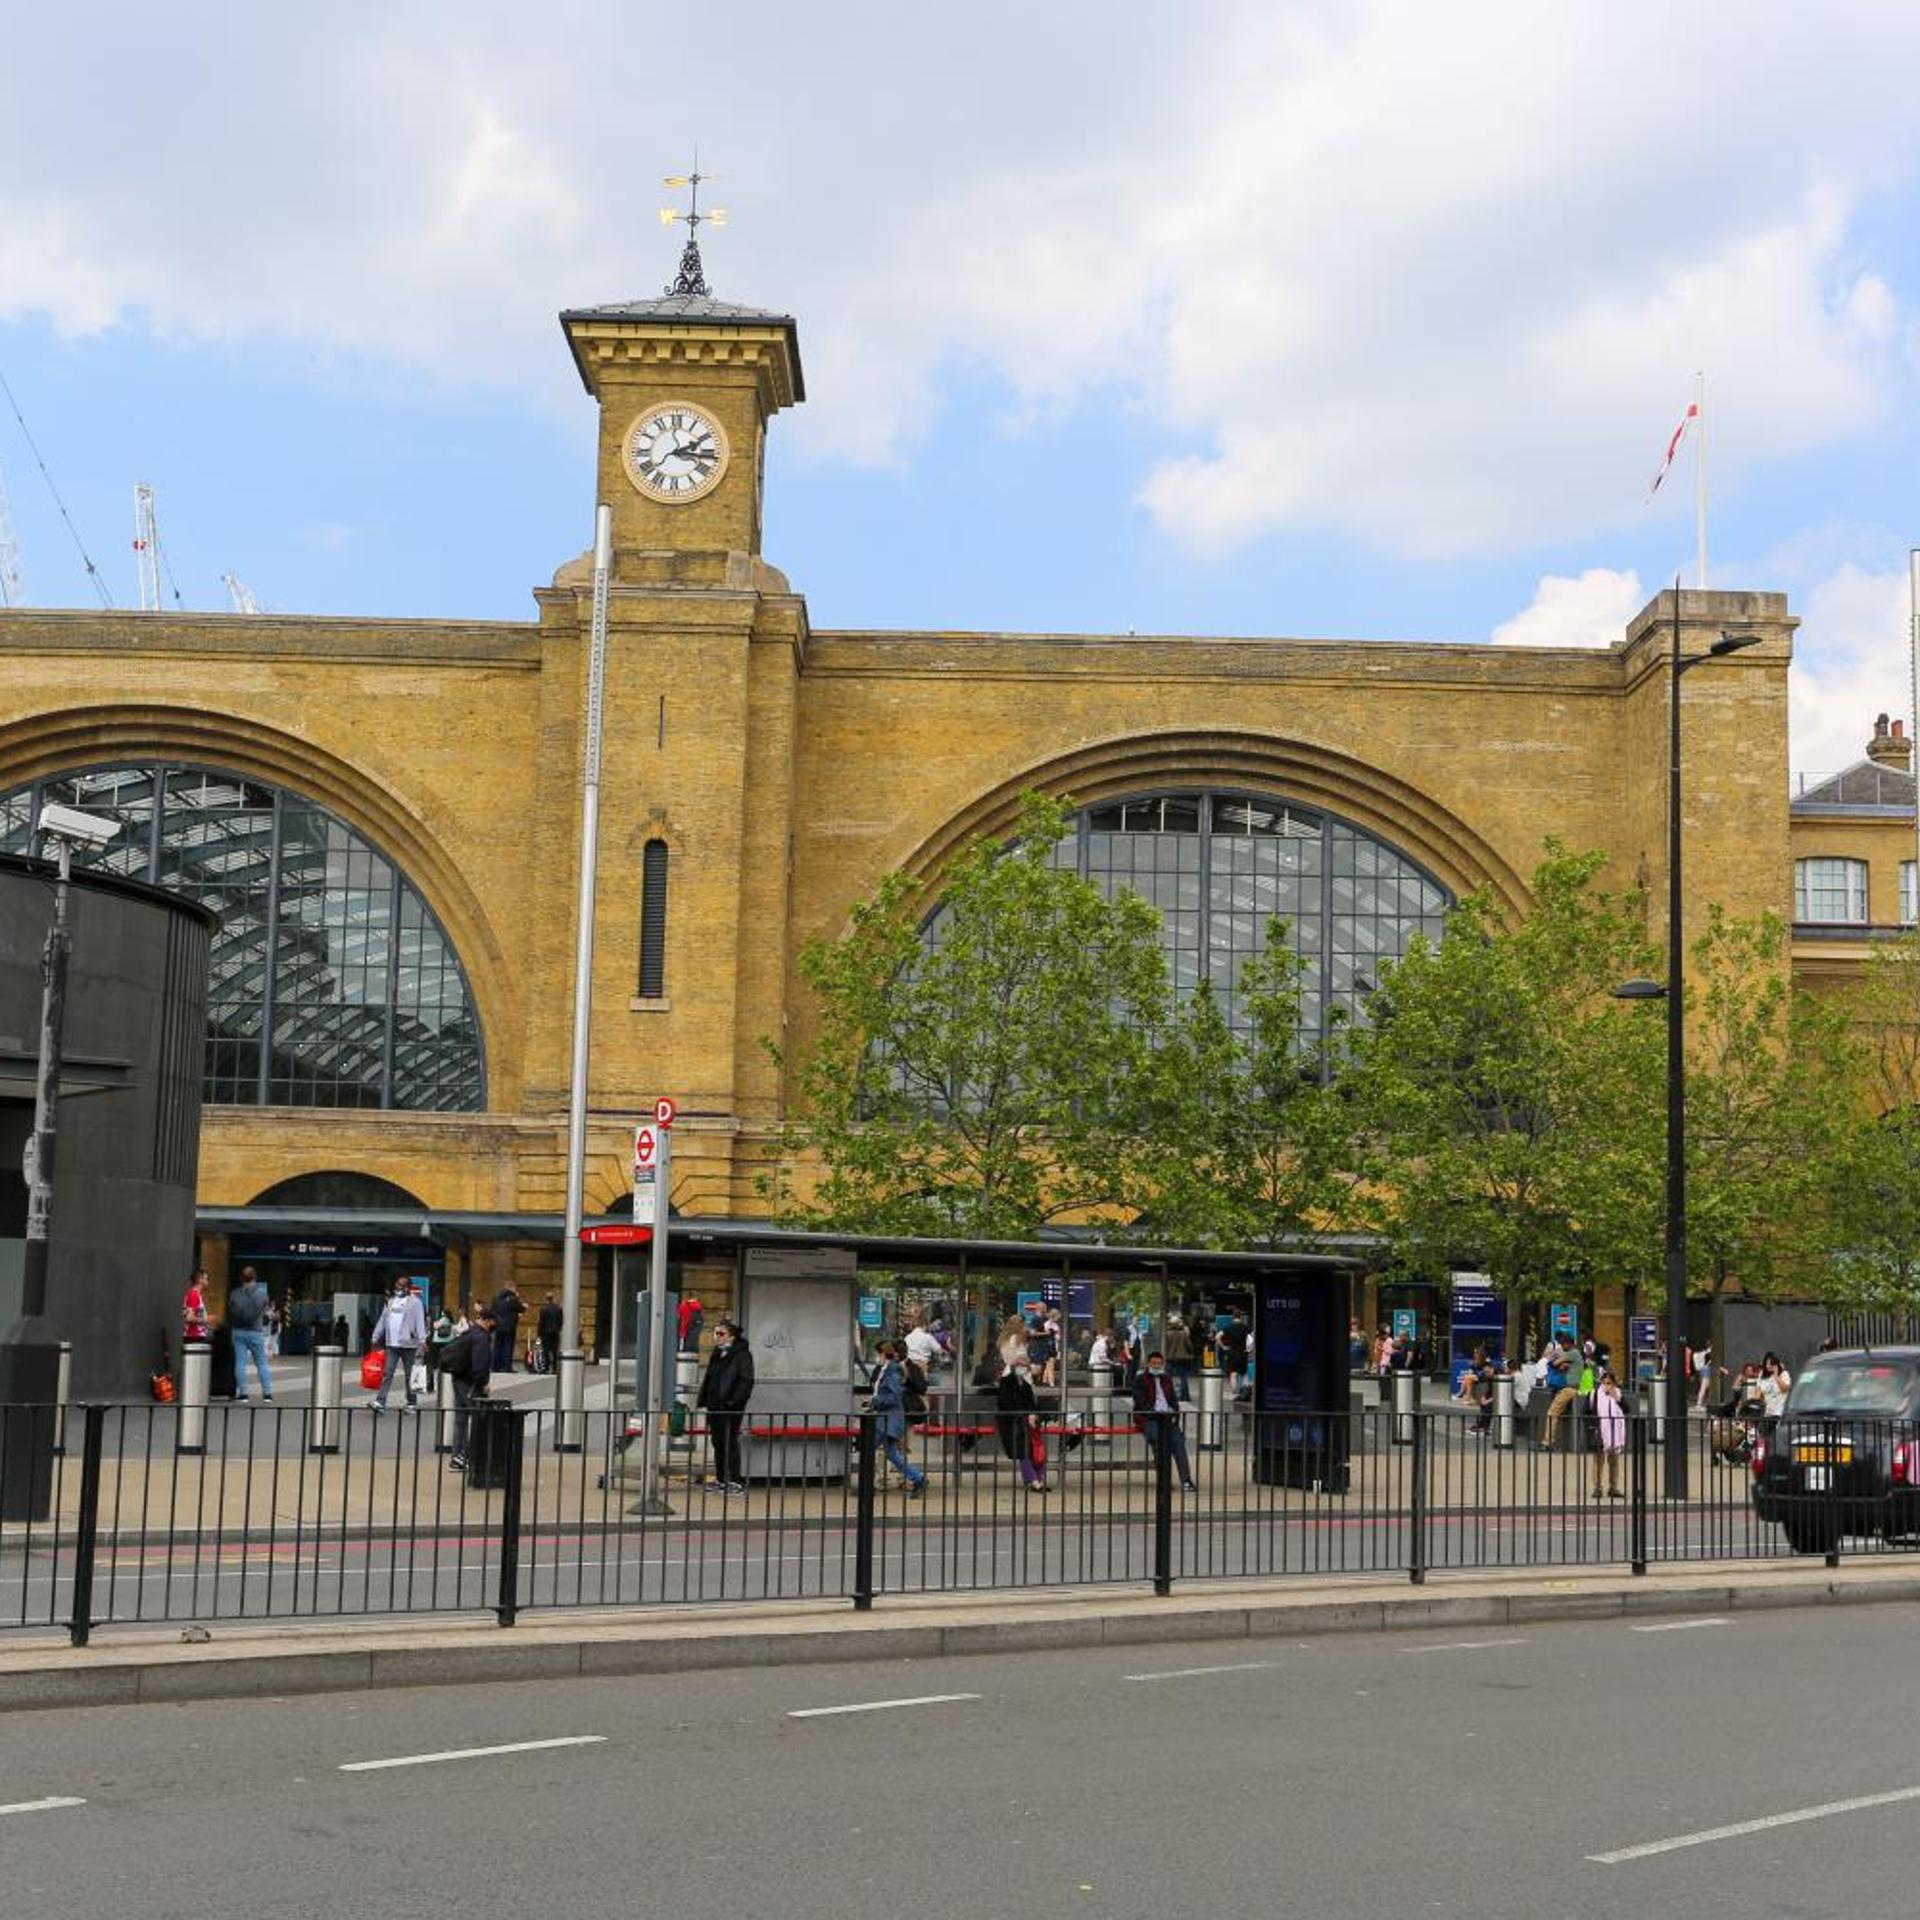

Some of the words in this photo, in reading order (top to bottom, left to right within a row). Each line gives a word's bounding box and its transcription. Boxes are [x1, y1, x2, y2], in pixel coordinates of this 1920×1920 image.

[659, 207, 676, 226] W
[709, 207, 729, 227] E
[658, 1101, 671, 1120] D
